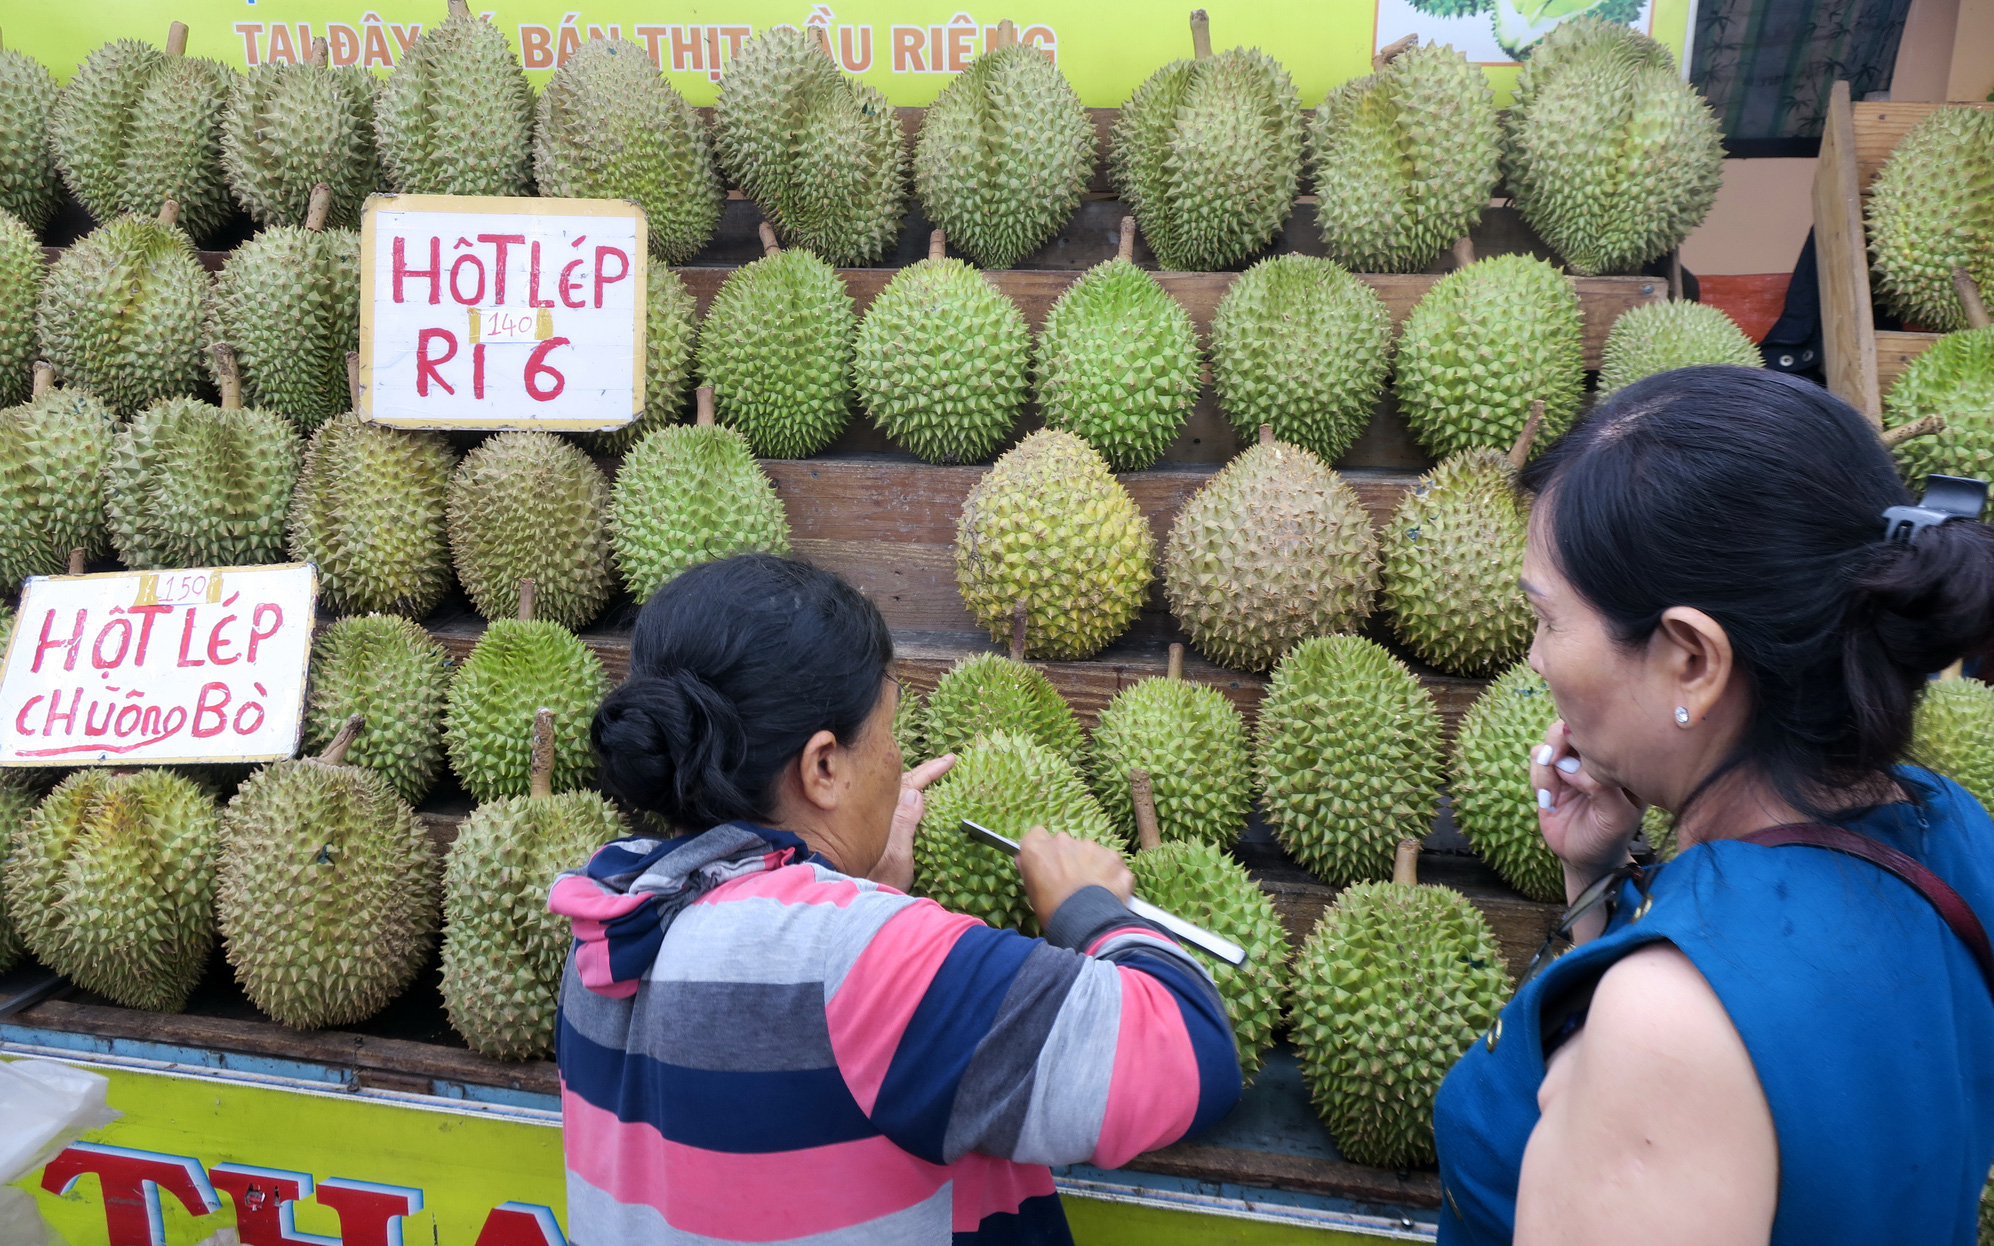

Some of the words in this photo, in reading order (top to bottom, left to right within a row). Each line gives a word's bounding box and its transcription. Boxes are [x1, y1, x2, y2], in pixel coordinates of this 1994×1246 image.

[327, 12, 421, 67] ĐÂY
[528, 234, 630, 309] LÉP
[487, 311, 533, 337] 140
[158, 575, 207, 602] 150
[30, 604, 175, 680] HỘT
[176, 590, 284, 668] LÉP
